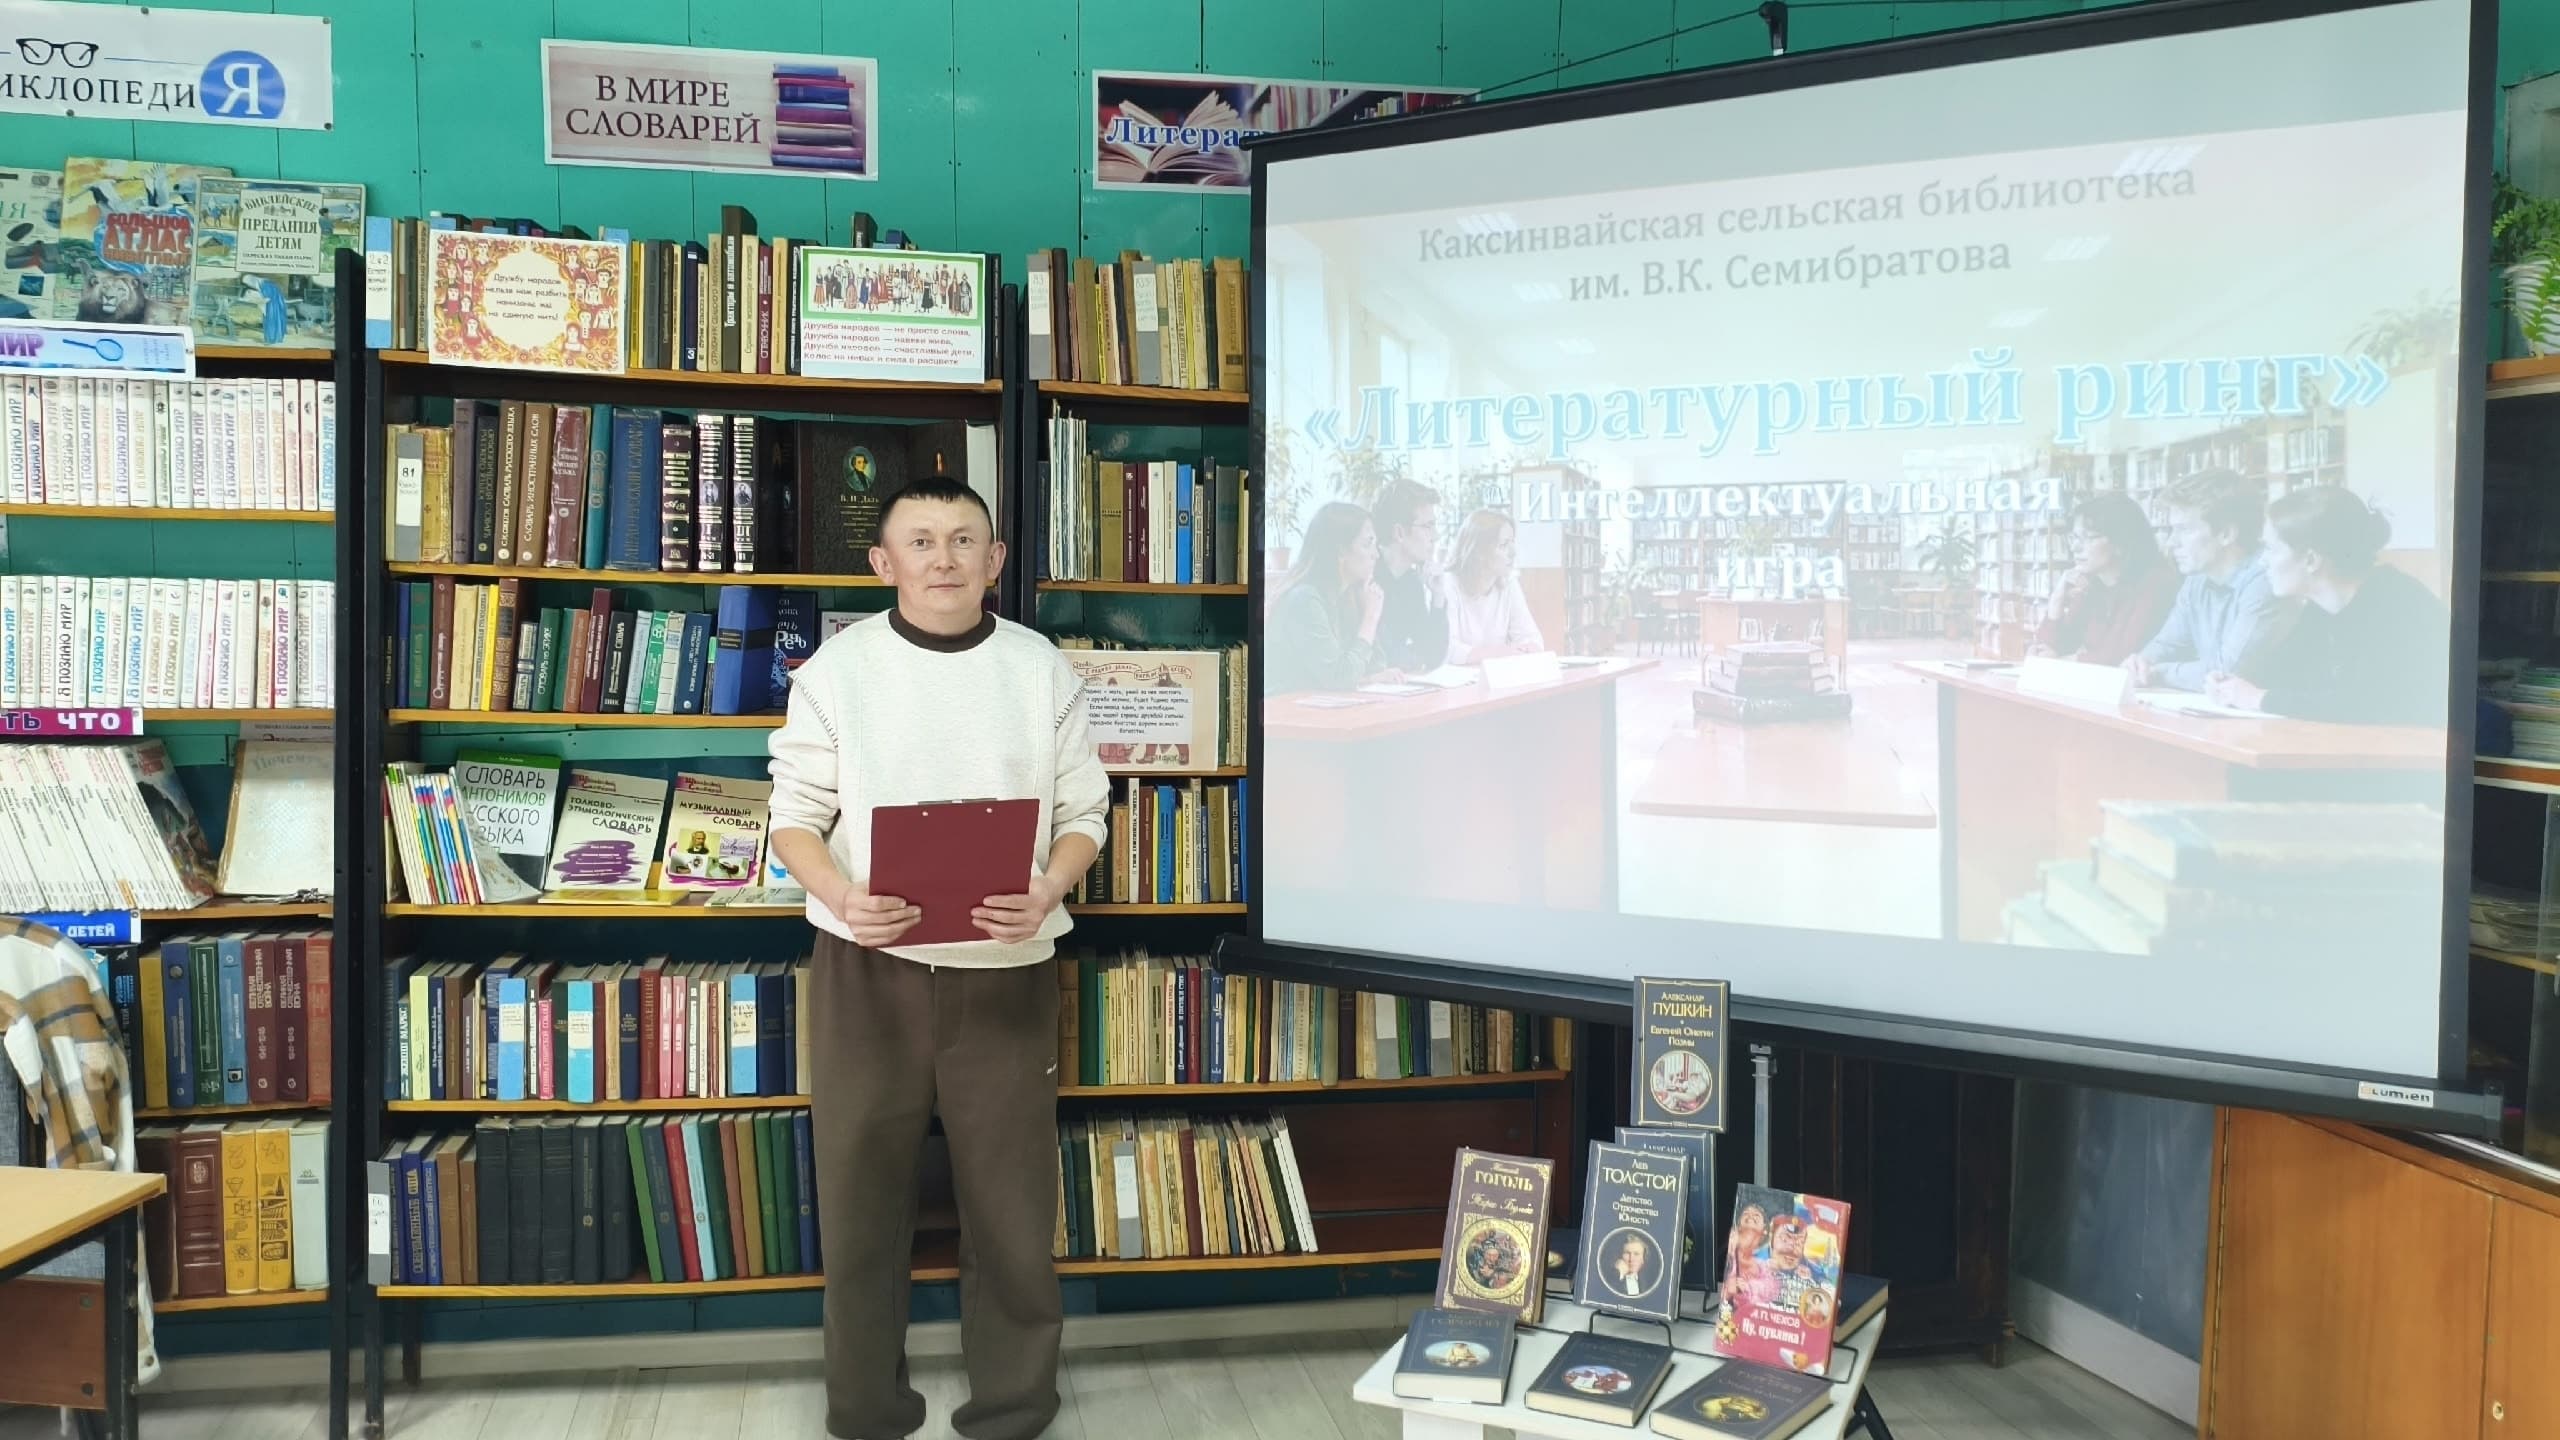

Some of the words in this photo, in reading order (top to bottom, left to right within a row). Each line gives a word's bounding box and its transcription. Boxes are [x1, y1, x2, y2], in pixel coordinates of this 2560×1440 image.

[595, 75, 617, 101] В
[625, 76, 730, 107] МИРЕ
[565, 108, 762, 144] СЛОВАРЕЙ
[1105, 117, 1270, 153] Литера
[242, 218, 318, 234] ПРЕДАНИЯ
[1418, 211, 1705, 263] Каксинвайская
[1717, 192, 1904, 234] сельская
[1918, 166, 2197, 219] библиотека
[104, 225, 192, 254] АТЛАС
[255, 236, 302, 250] ДЕТЯМ
[1569, 272, 1630, 301] им.
[1641, 258, 1713, 296] В.К.
[1725, 241, 2012, 290] Семибратова
[803, 322, 839, 332] Дружба
[803, 332, 839, 342] Дружба
[0, 332, 44, 358] ИР
[1303, 346, 2024, 461] «Литературный
[2053, 352, 2391, 445] ринг»
[507, 406, 515, 434] ЯЗЫКА
[530, 413, 540, 437] СЛОВ
[505, 433, 514, 473] РУССКОГО
[402, 467, 416, 478] 81
[527, 438, 539, 502] ИНОСТРАННЫХ
[502, 473, 512, 507] СЛОВАРЬ
[1518, 477, 2063, 527] Интеллектуальная
[524, 504, 535, 542] СЛОВАРЬ
[1716, 548, 1846, 598] игра
[60, 604, 72, 630] МИР
[59, 634, 71, 684] ПОЗНАЮ
[57, 712, 121, 730] ЧТО
[466, 766, 546, 789] СЛОВАРЬ
[568, 805, 655, 823] ЭТИМОЛОГИЧЕСКИЙ
[570, 796, 616, 810] ТОЛКОВО-
[679, 800, 752, 817] МУЗЫКАЛЬНЫЙ
[470, 804, 540, 826] УССКОГО
[592, 817, 652, 834] СЛОВАРЬ
[712, 816, 762, 830] СЛОВАРЬ
[67, 923, 116, 938] ДЕТЕЙ
[1652, 1002, 1713, 1019] ПУШКИН
[399, 1007, 409, 1039] МАРКС
[1650, 1025, 1682, 1036] Евгений
[1683, 1027, 1714, 1038] Онегин
[1668, 1036, 1695, 1048] Поэмы
[1631, 1159, 1649, 1170] Лев
[1475, 1170, 1534, 1192] ГОГОЛЬ
[1602, 1166, 1677, 1192] ТОЛСТОЙ
[1618, 1213, 1650, 1226] Юность
[1770, 1312, 1801, 1329] ЧЕХОВ
